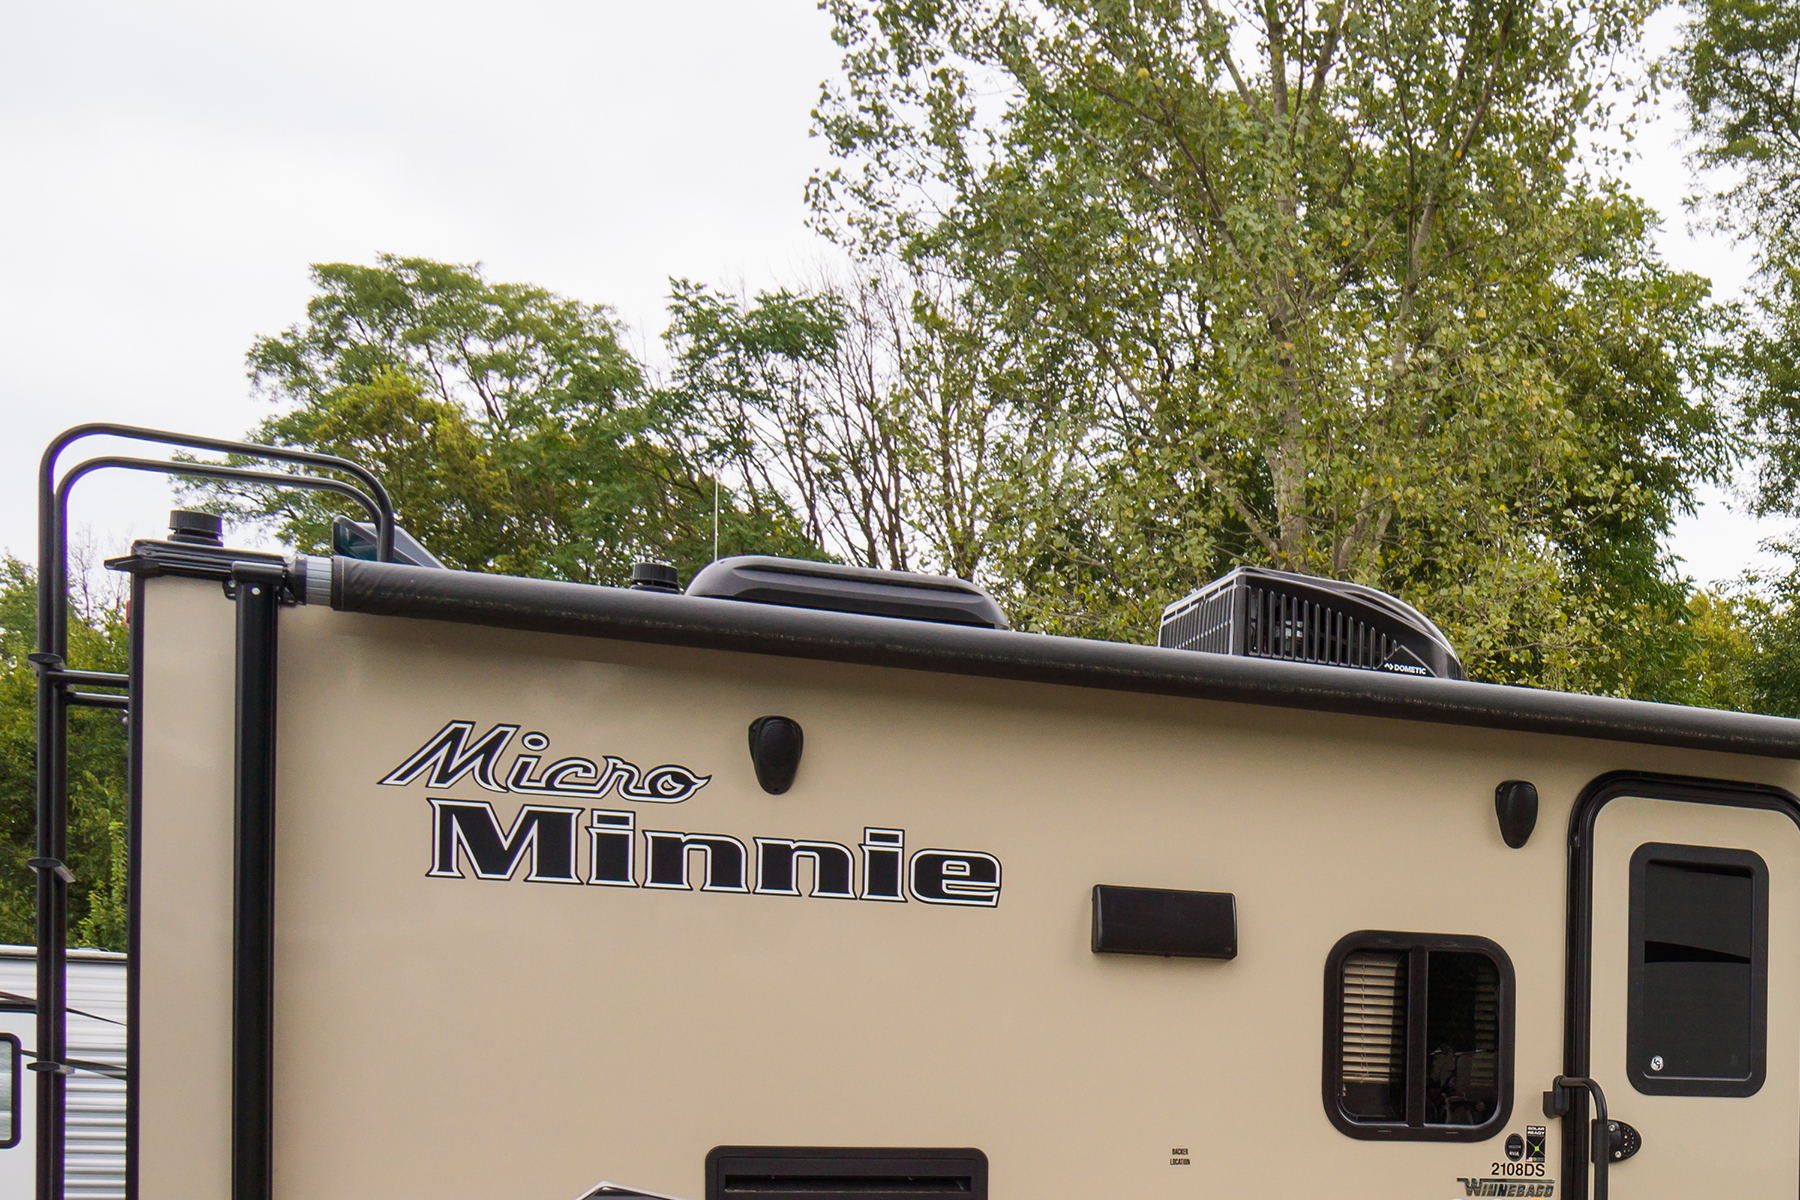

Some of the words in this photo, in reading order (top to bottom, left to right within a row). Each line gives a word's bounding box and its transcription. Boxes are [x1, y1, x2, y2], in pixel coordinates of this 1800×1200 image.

[1394, 663, 1427, 675] DOMETIC
[377, 720, 712, 804] Micro
[425, 798, 1001, 908] Minnie
[1491, 1162, 1545, 1177] 2108DS
[1456, 1178, 1555, 1198] WINNEBAGO
